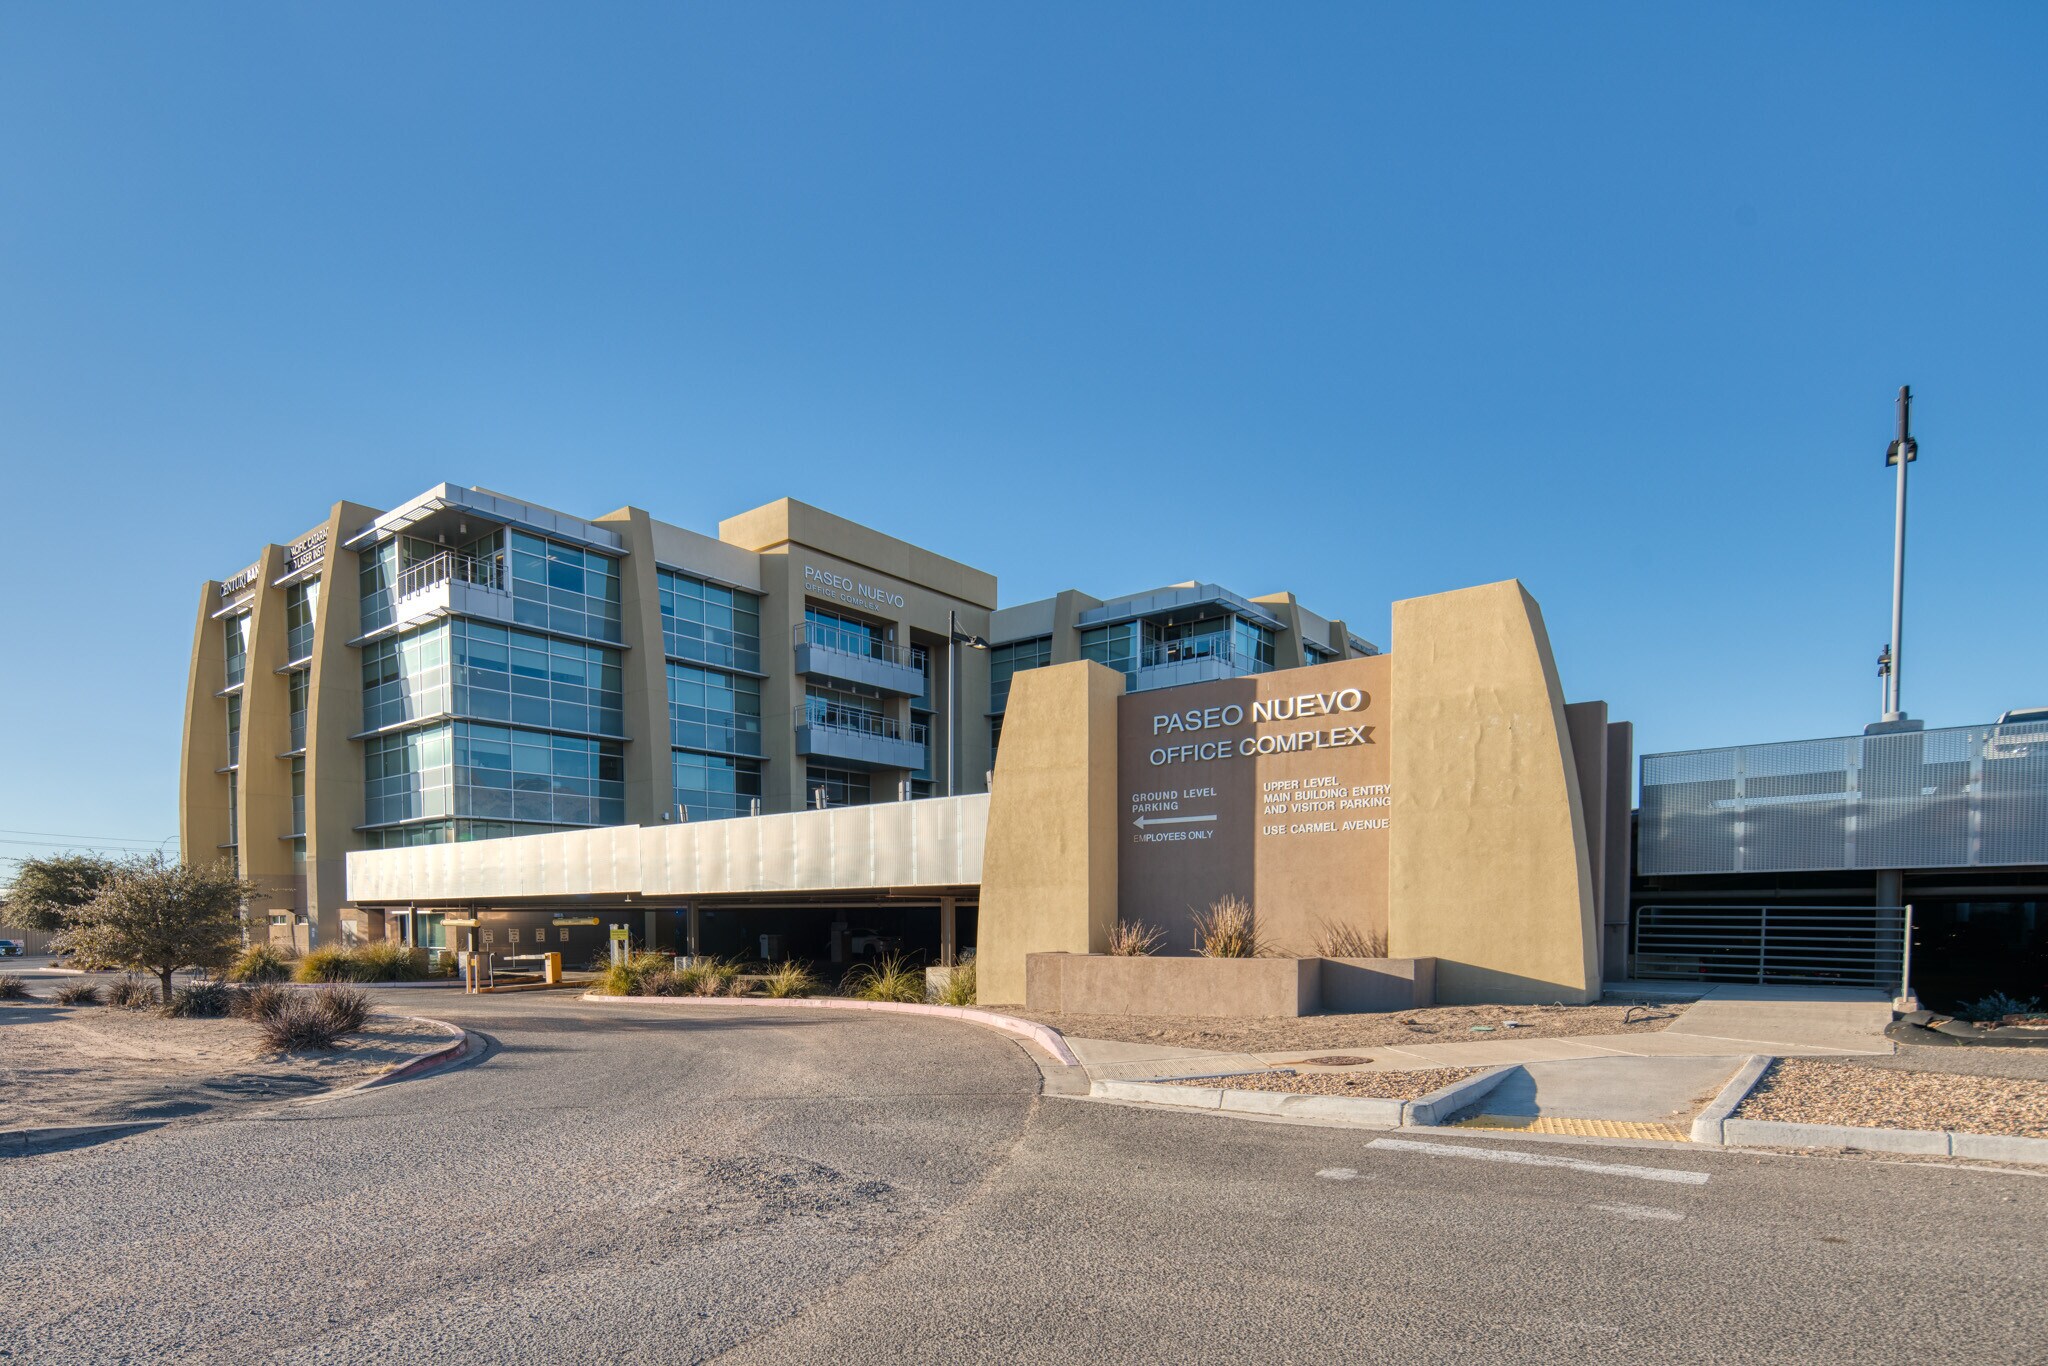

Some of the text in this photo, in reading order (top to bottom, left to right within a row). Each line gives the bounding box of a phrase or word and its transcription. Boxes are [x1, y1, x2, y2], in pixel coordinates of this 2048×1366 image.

[220, 571, 248, 597] CENTURY
[804, 565, 904, 608] PASEO NUEVO
[805, 582, 880, 612] OFFICE COMPLEX
[1153, 688, 1363, 736] PASEO NUEVO
[1150, 725, 1367, 766] OFFICE COMPLEX
[1263, 776, 1340, 792] UPPER LEVEL
[1132, 787, 1217, 803] GROUND LEVEL
[1263, 784, 1391, 804] MAIN BUILDING ENTRY
[1132, 801, 1179, 813] PARKING
[1264, 796, 1391, 815] AND VISITOR PARKING
[1133, 829, 1214, 843] EMPLOYEES ONLY
[1263, 818, 1389, 836] USE CARMEL AVENUE
